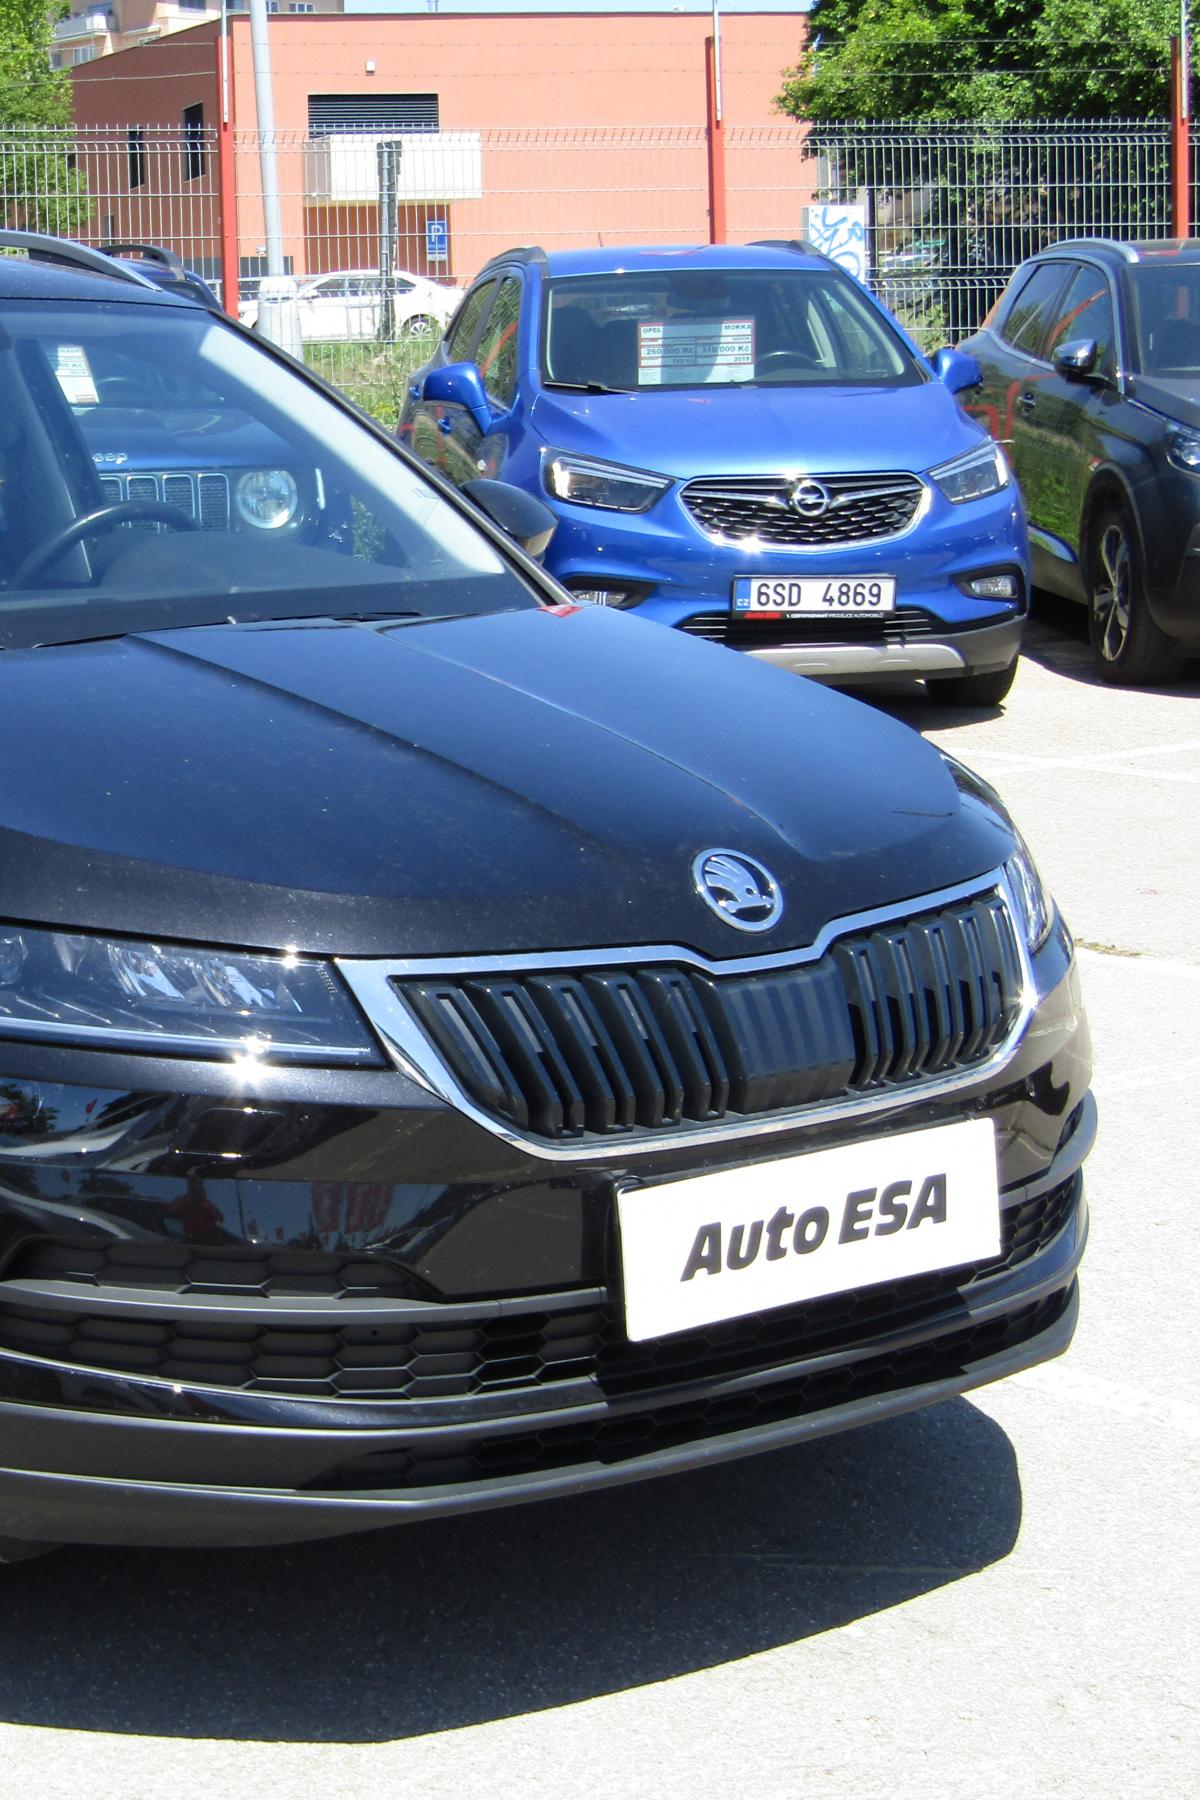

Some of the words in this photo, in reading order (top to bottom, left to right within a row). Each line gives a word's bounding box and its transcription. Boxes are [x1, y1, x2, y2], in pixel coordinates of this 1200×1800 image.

[91, 452, 128, 464] eep
[737, 598, 749, 607] CZ
[757, 583, 801, 607] 6SD
[822, 583, 882, 607] 4869
[679, 1205, 830, 1282] Auto
[837, 1172, 948, 1245] ESA
